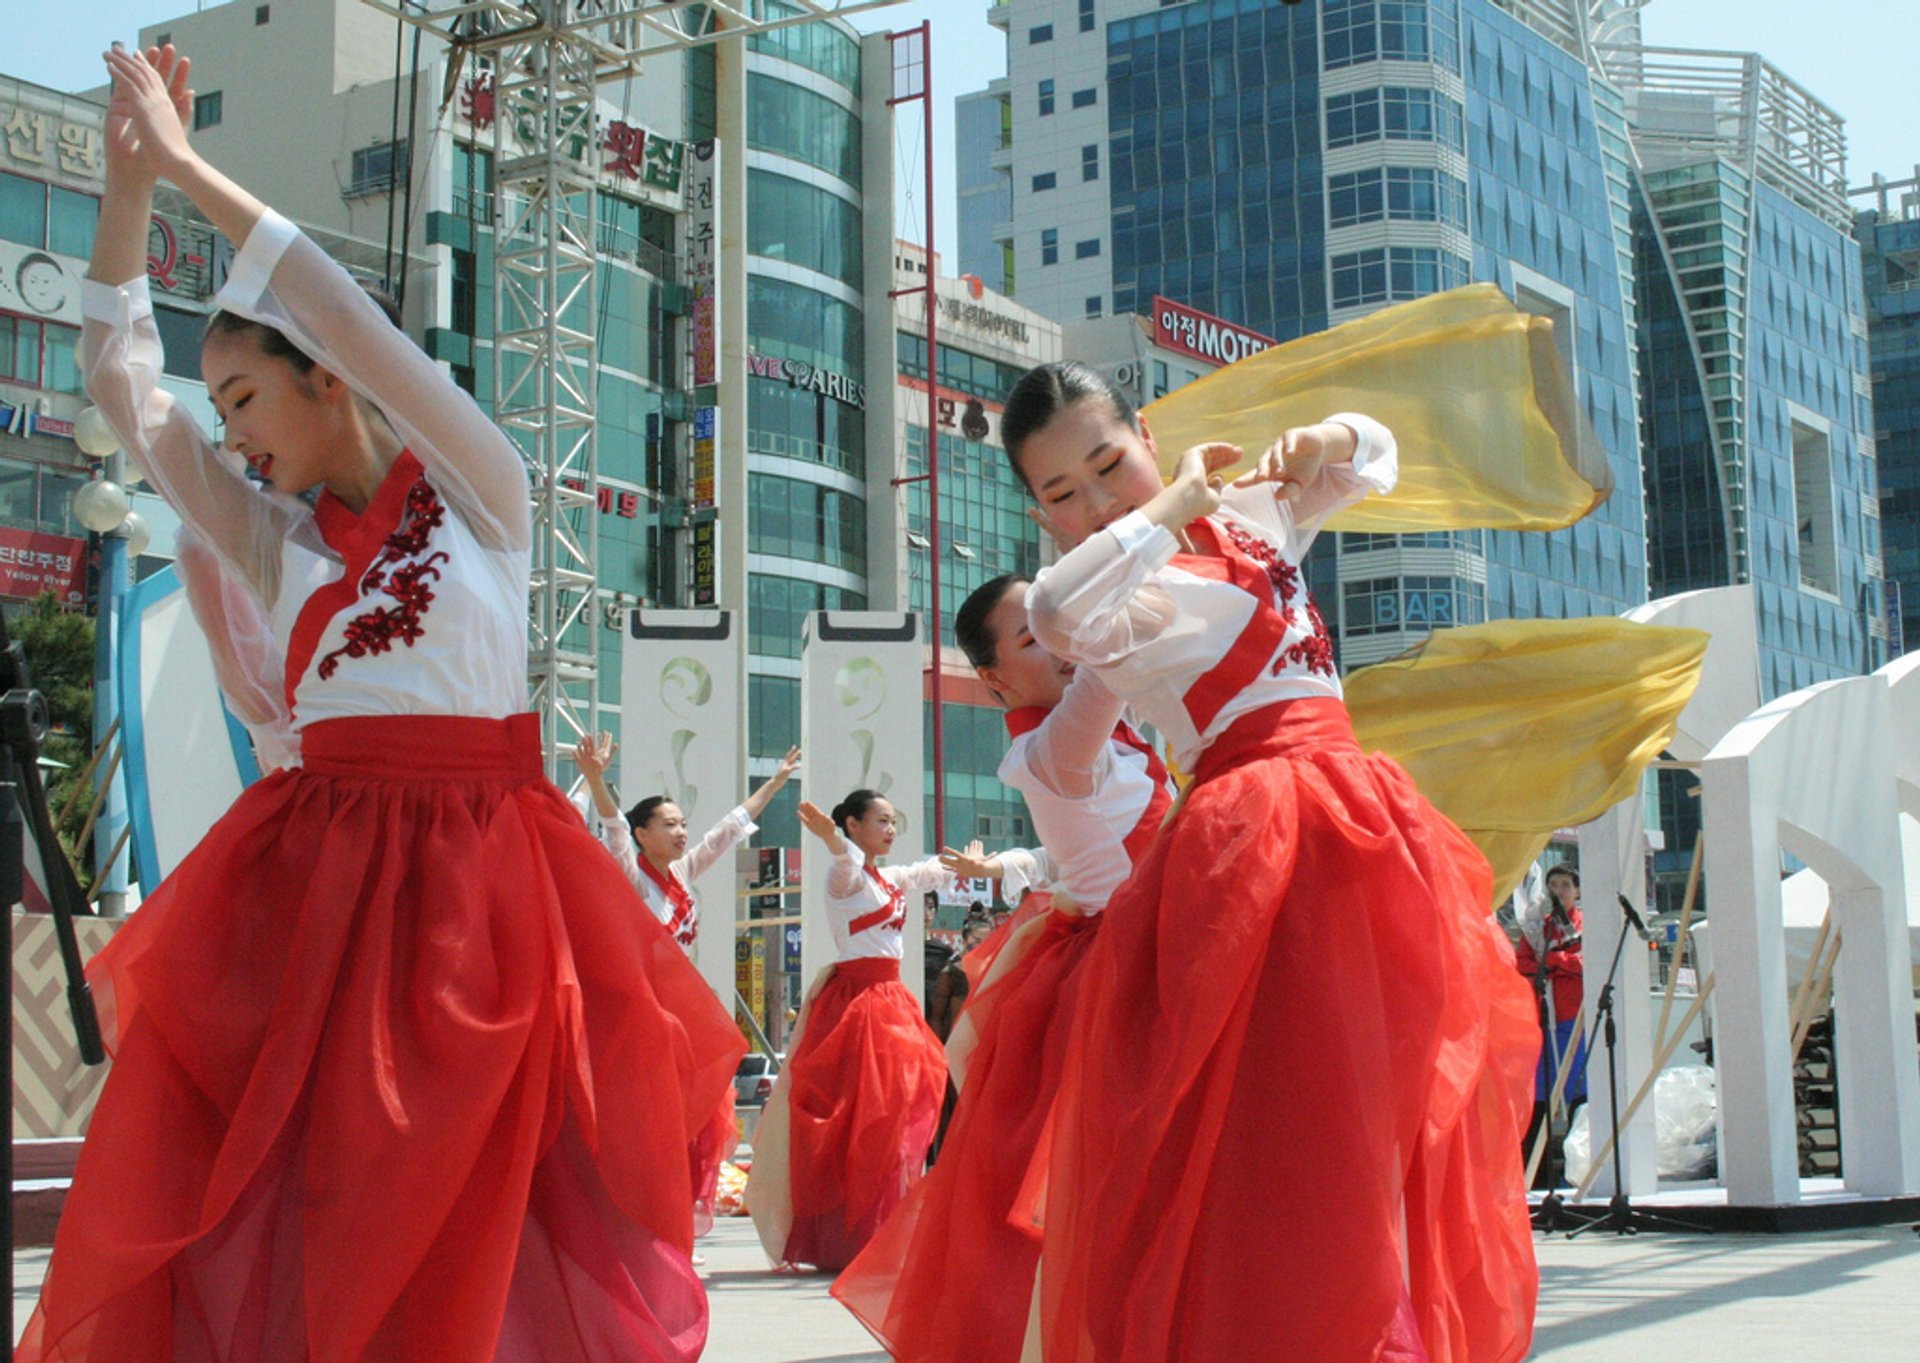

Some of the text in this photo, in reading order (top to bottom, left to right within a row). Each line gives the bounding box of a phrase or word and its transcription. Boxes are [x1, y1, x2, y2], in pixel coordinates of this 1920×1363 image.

[5, 108, 97, 178] 선원
[1162, 311, 1270, 364] 아정 MOT
[808, 366, 866, 411] ARIES
[1376, 591, 1453, 623] BAR
